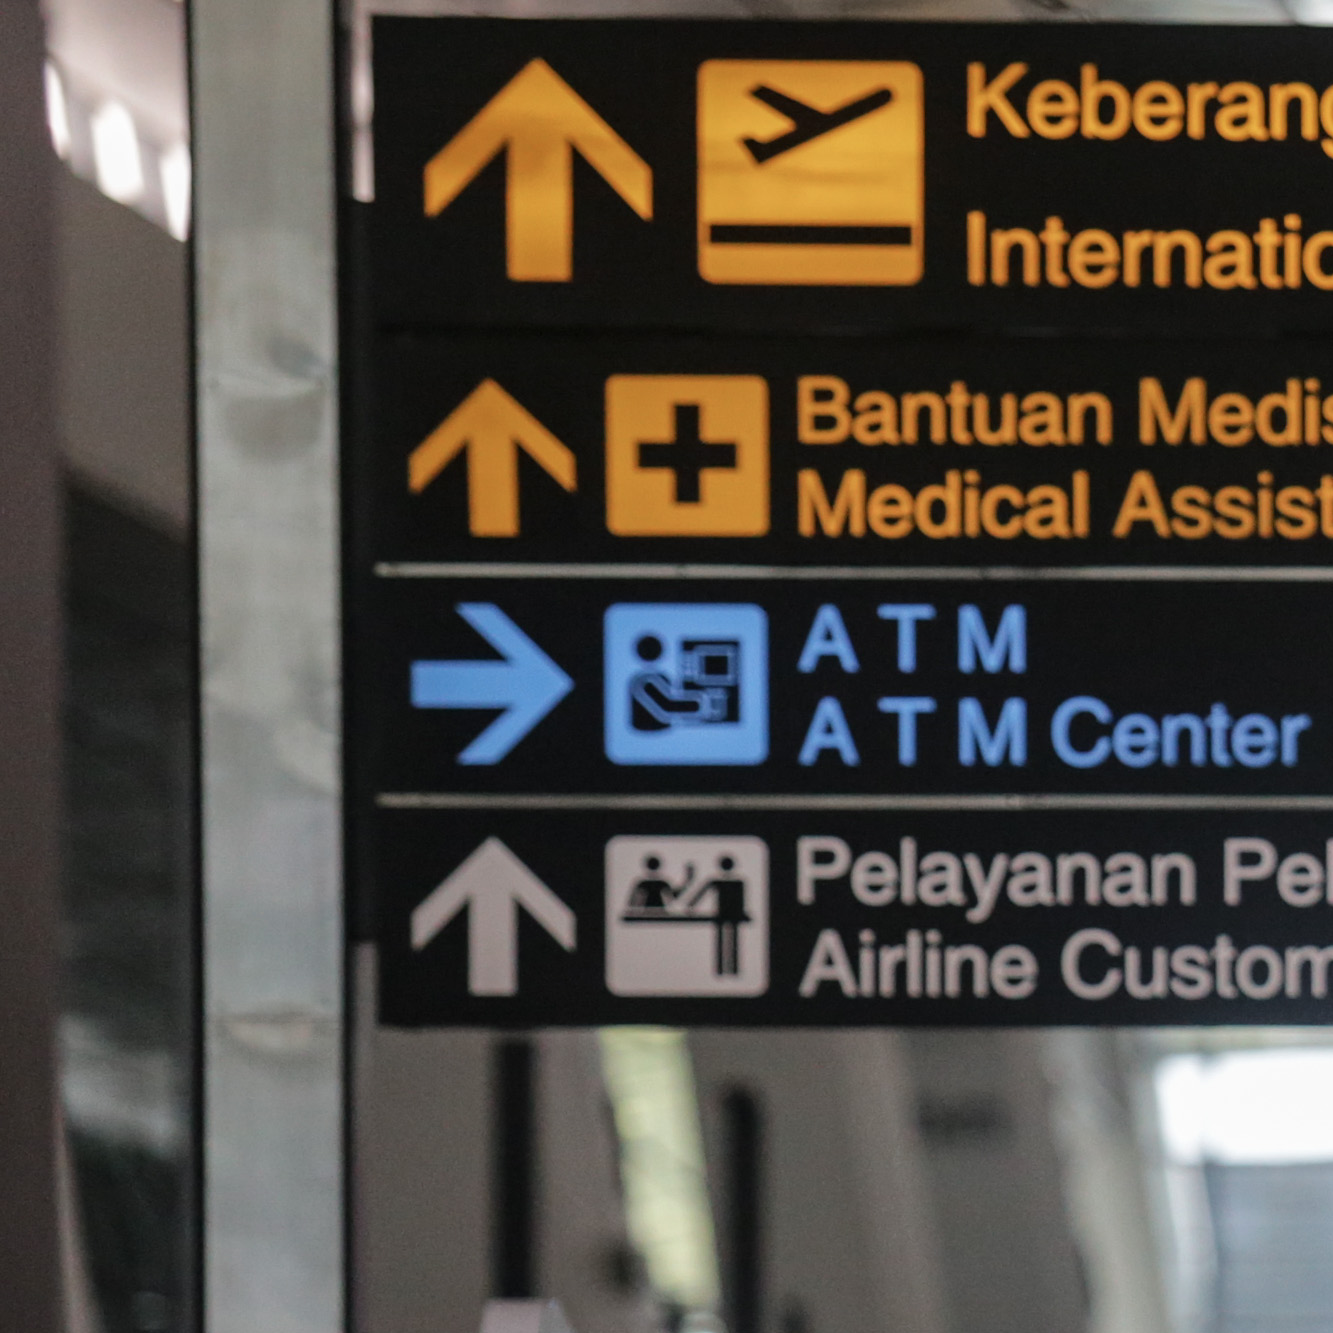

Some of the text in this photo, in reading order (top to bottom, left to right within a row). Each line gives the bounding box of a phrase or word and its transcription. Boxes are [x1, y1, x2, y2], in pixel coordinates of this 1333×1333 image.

[797, 375, 1113, 447] Bantuan
[797, 468, 1090, 539] Medical
[1050, 695, 1312, 769] Center
[797, 836, 1195, 923] Pelayanan
[800, 929, 1038, 998] Airline
